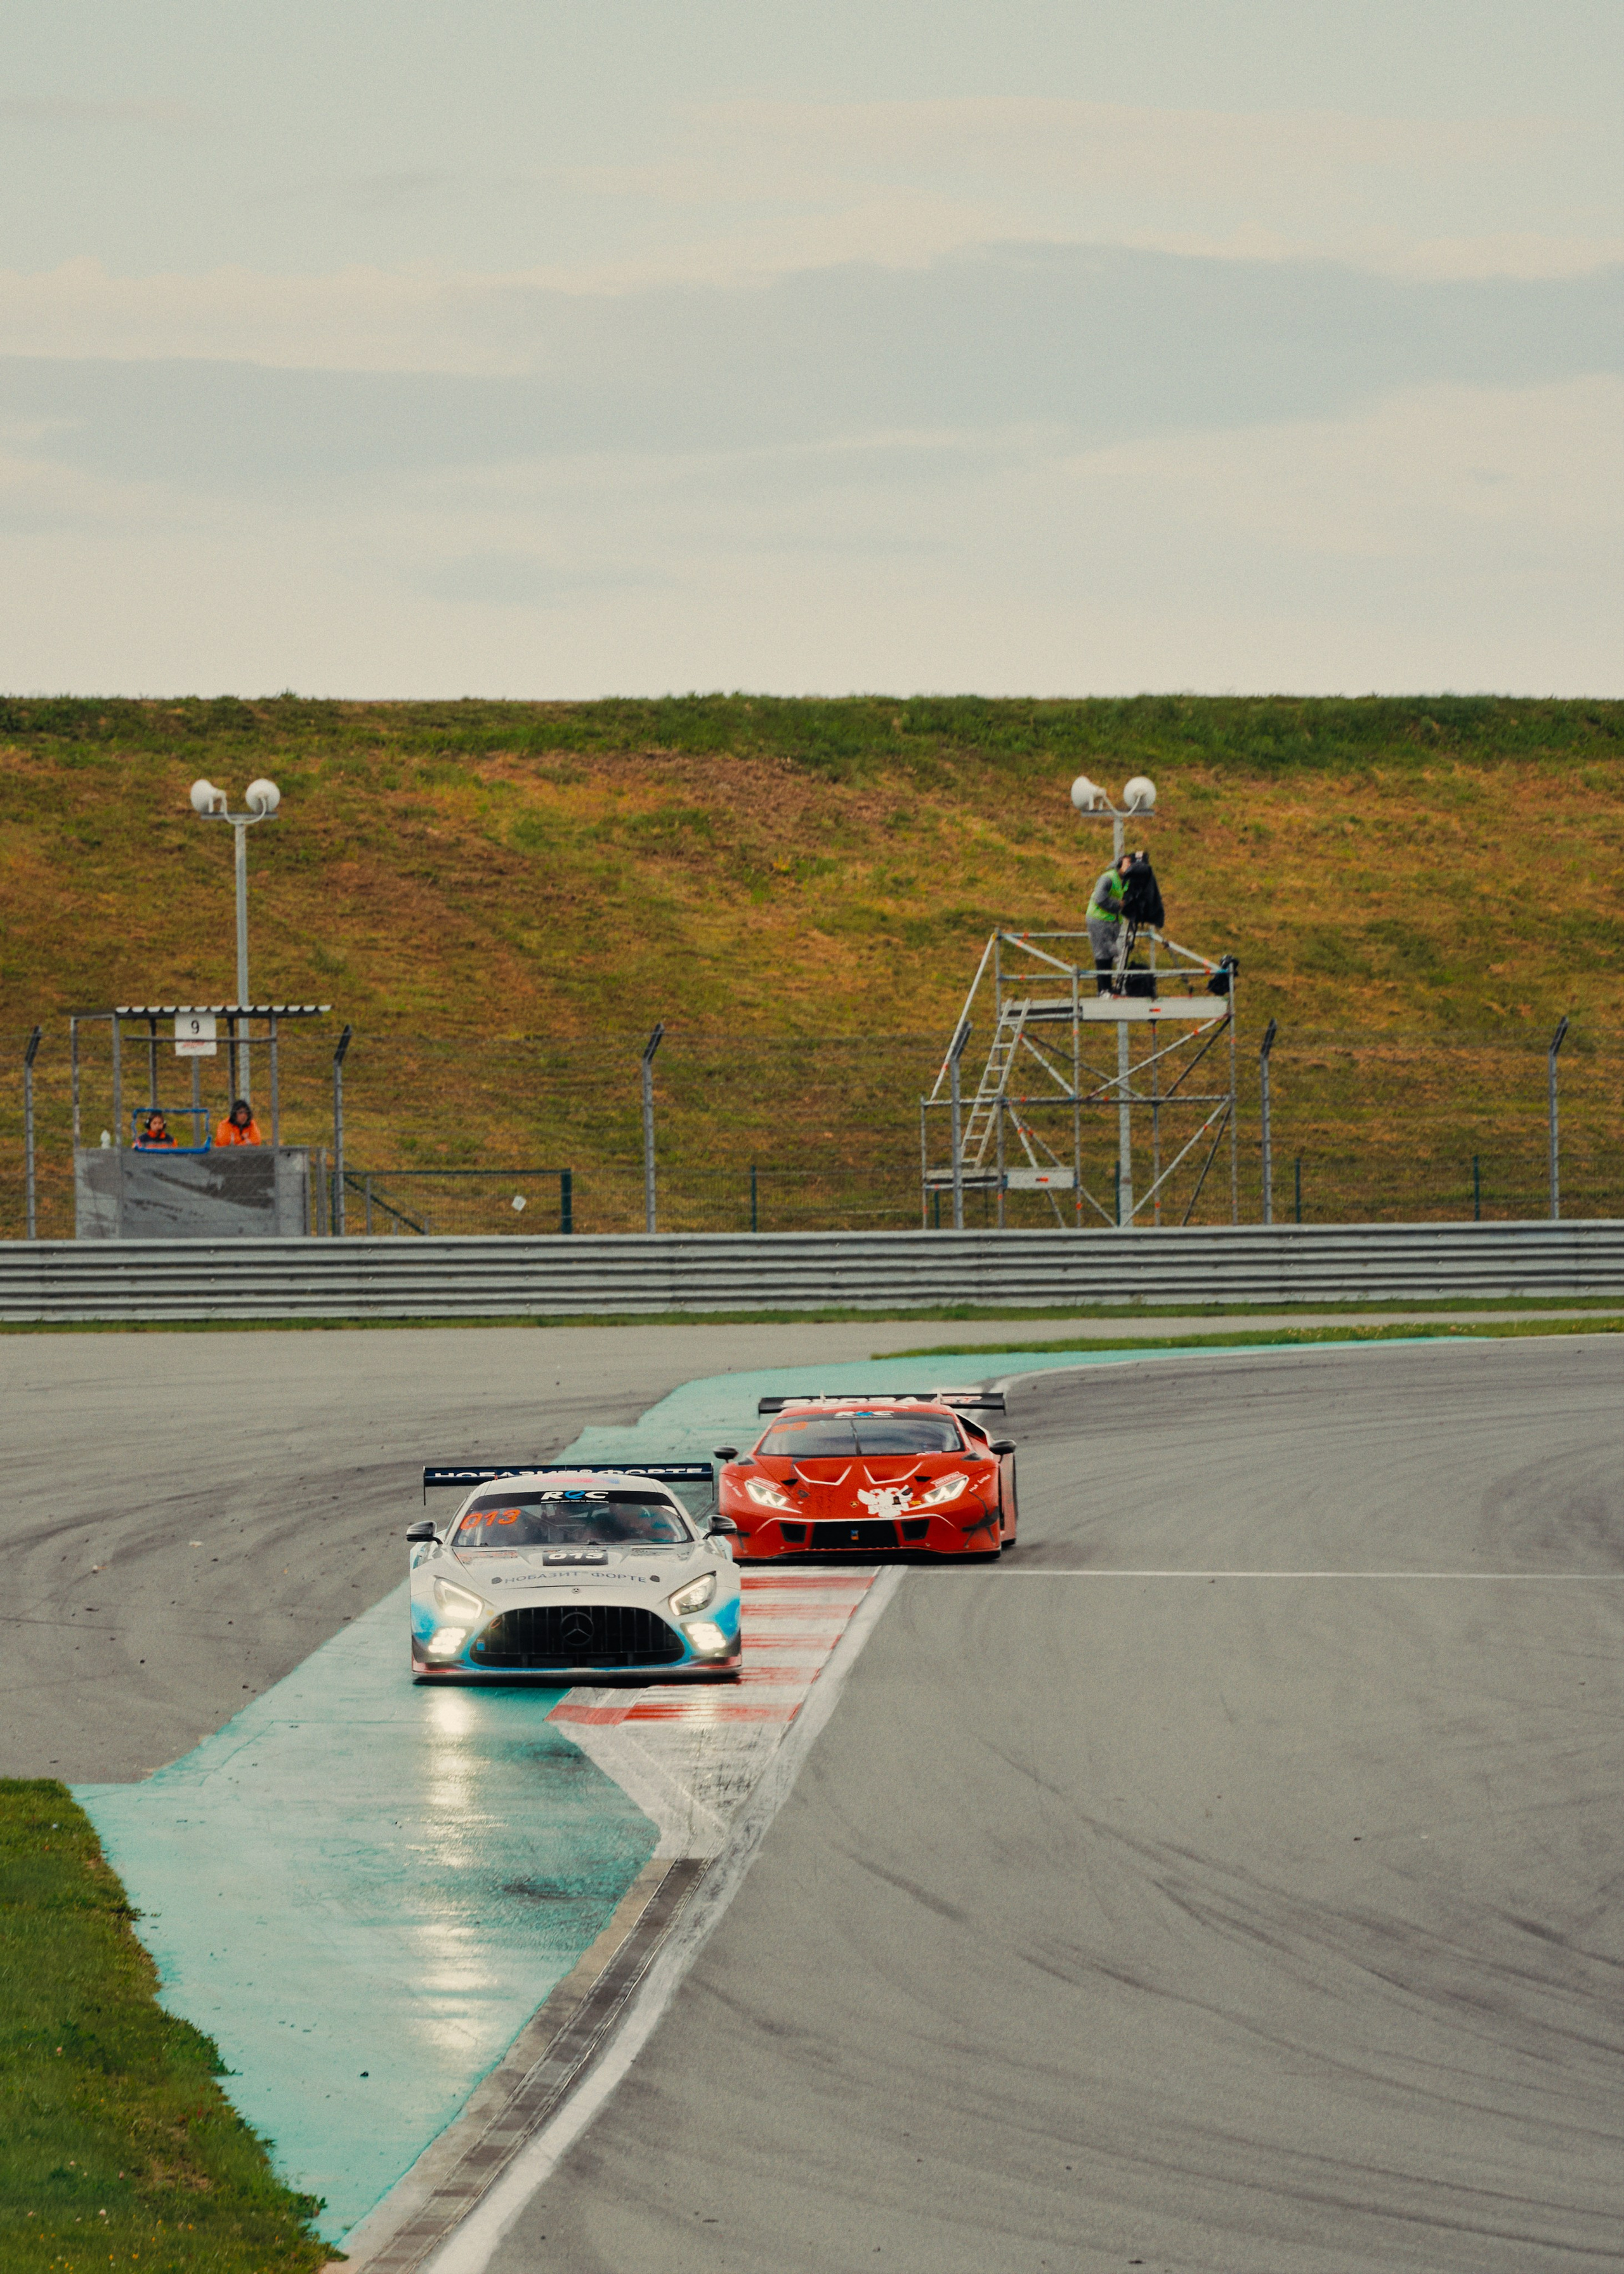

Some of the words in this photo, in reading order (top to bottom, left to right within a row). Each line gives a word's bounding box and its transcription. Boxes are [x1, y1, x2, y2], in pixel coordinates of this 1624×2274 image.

[191, 1020, 200, 1034] 9
[460, 1509, 521, 1530] 013
[591, 1572, 647, 1583] ФОРТЕ
